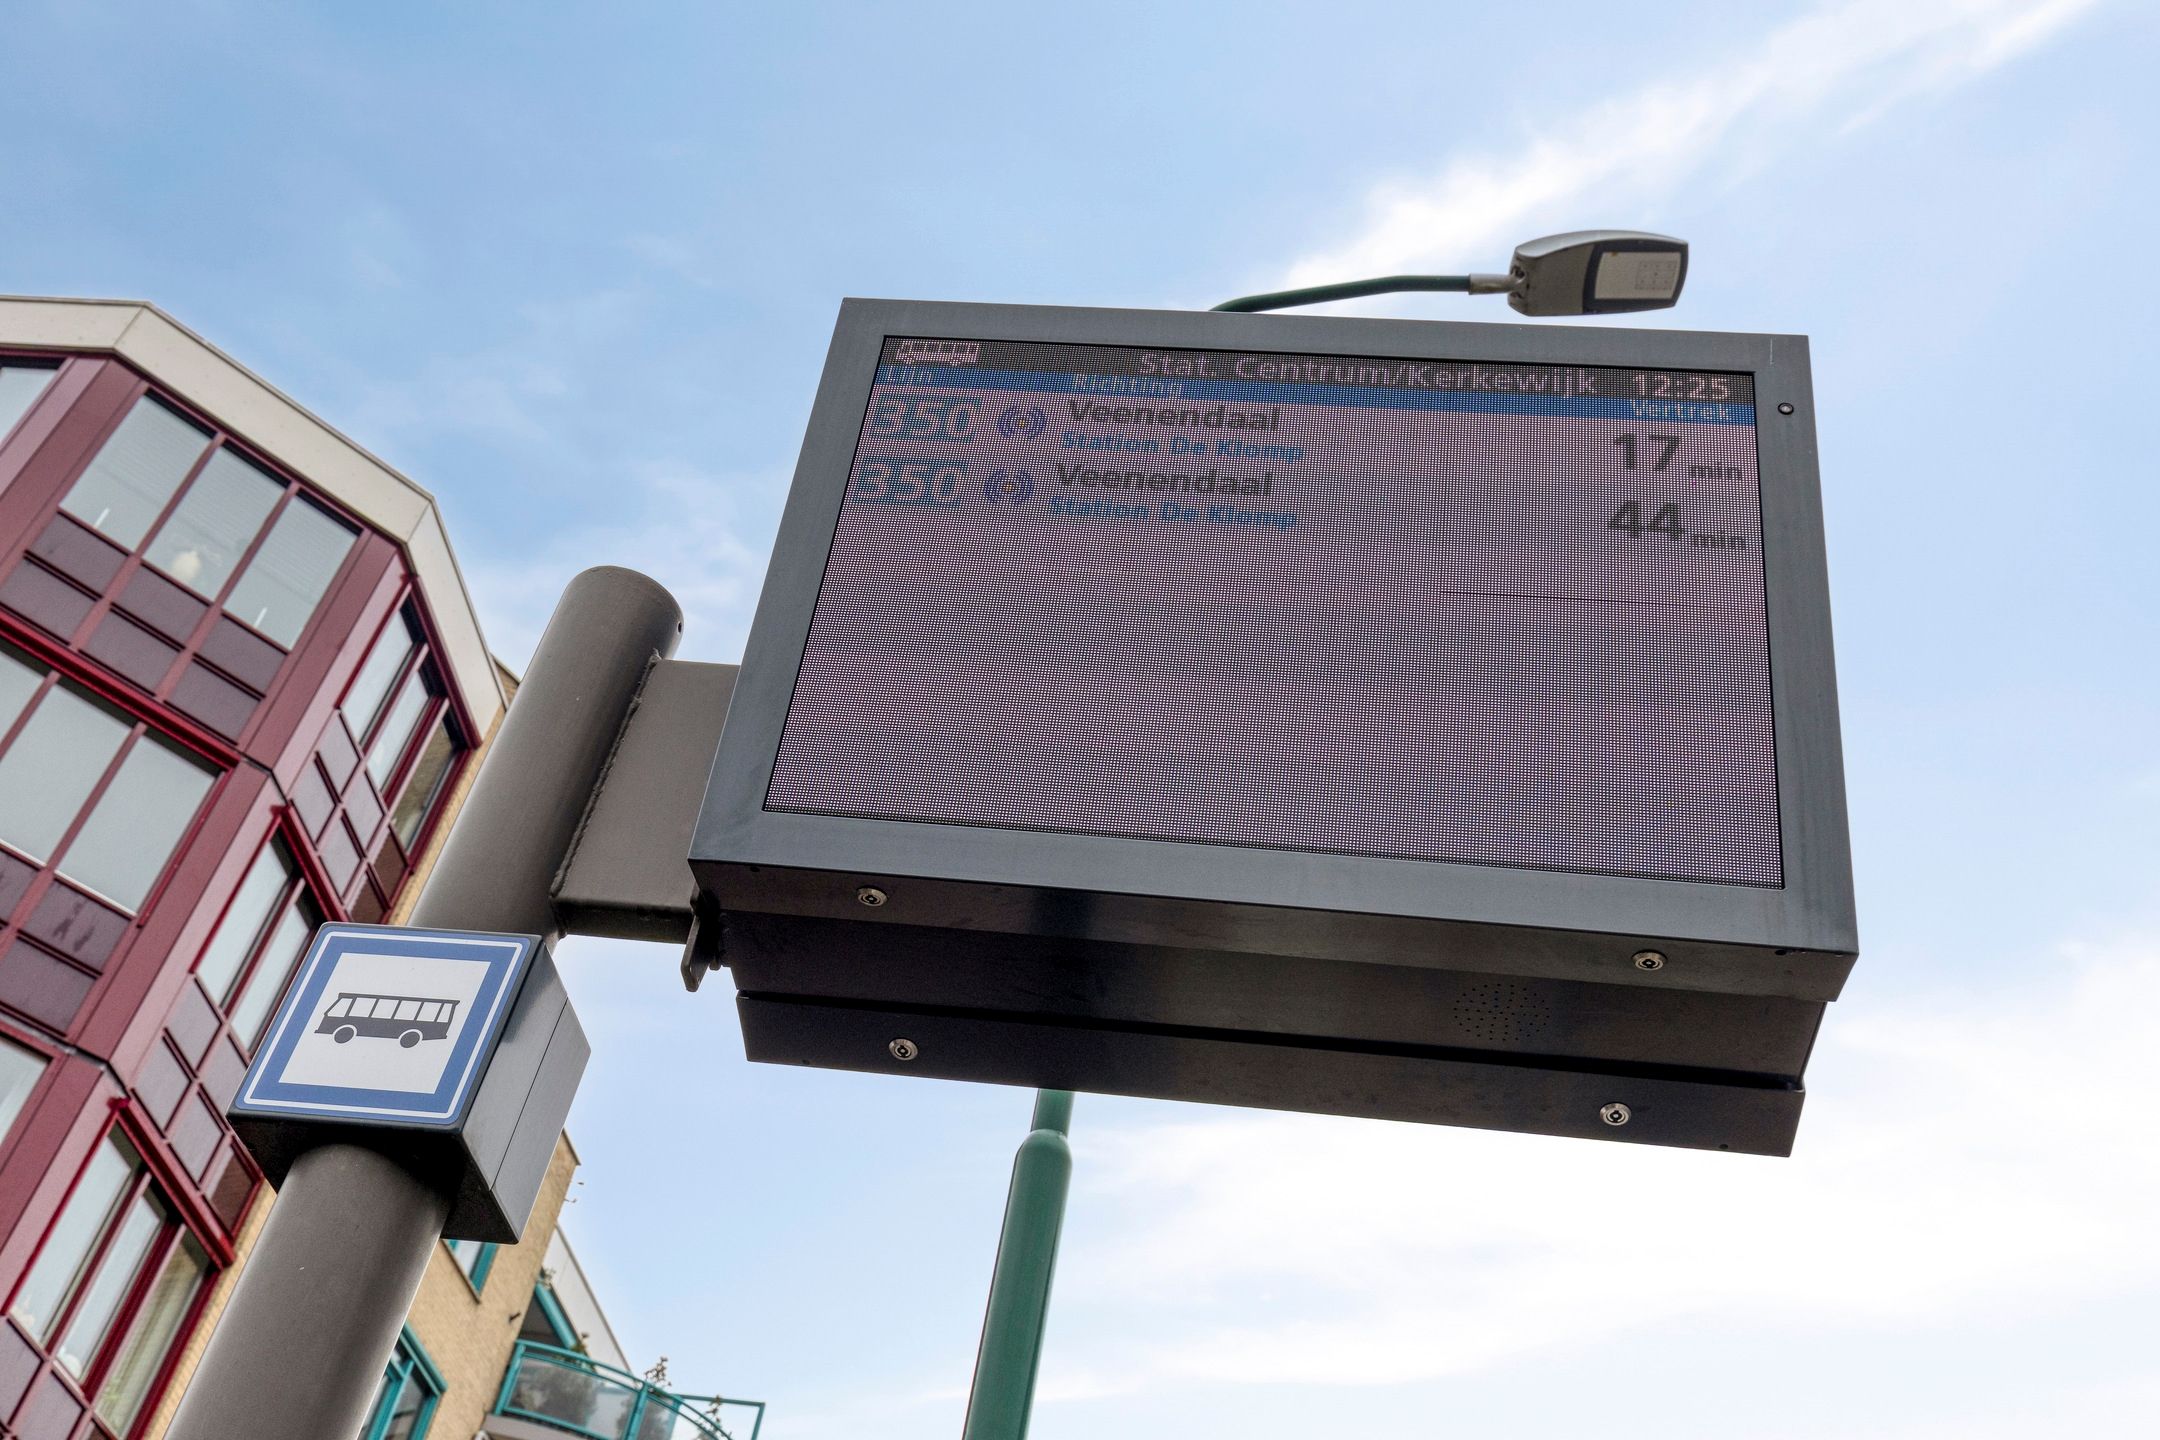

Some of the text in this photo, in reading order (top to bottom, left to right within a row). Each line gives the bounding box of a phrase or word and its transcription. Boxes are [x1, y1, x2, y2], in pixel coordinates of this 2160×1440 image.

[886, 367, 933, 386] Lijn
[1072, 374, 1183, 396] Richting
[1234, 357, 1597, 398] Centrum/Kerkewijk
[1632, 374, 1730, 400] 12:25
[873, 398, 977, 439] 350
[1068, 400, 1280, 431] Veenendaal
[1631, 400, 1730, 420] Vertrek
[1062, 432, 1305, 463] Station De Klomp
[1613, 433, 1743, 480] 17 min
[857, 463, 964, 504] 350
[1056, 464, 1273, 496] Veenendaal
[1050, 497, 1297, 529] Station De Klomp
[1608, 500, 1746, 550] 44 min
